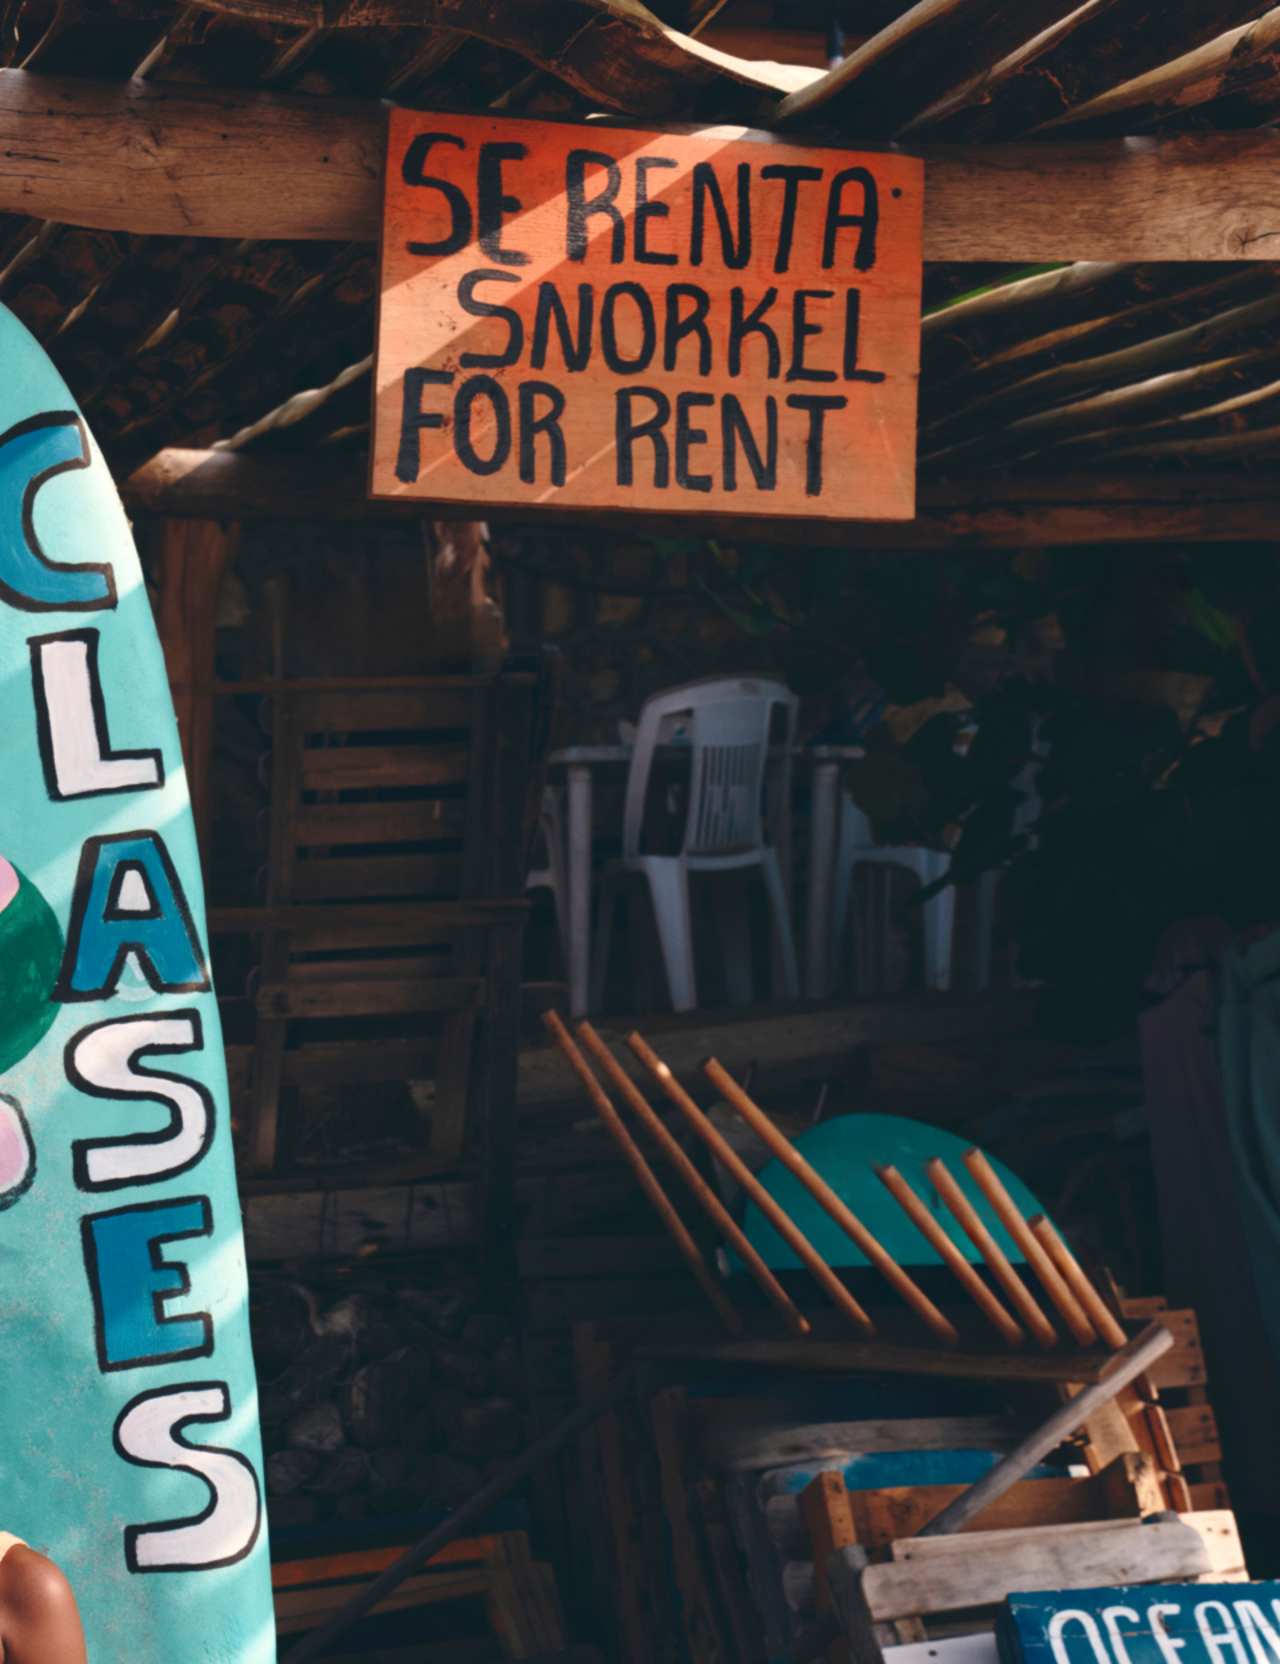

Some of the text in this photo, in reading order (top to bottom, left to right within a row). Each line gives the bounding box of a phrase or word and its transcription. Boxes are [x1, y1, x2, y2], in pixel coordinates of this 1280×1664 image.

[401, 131, 879, 273] SE RENTA
[457, 268, 887, 383] SNORKEL
[393, 366, 848, 497] FOR RENT
